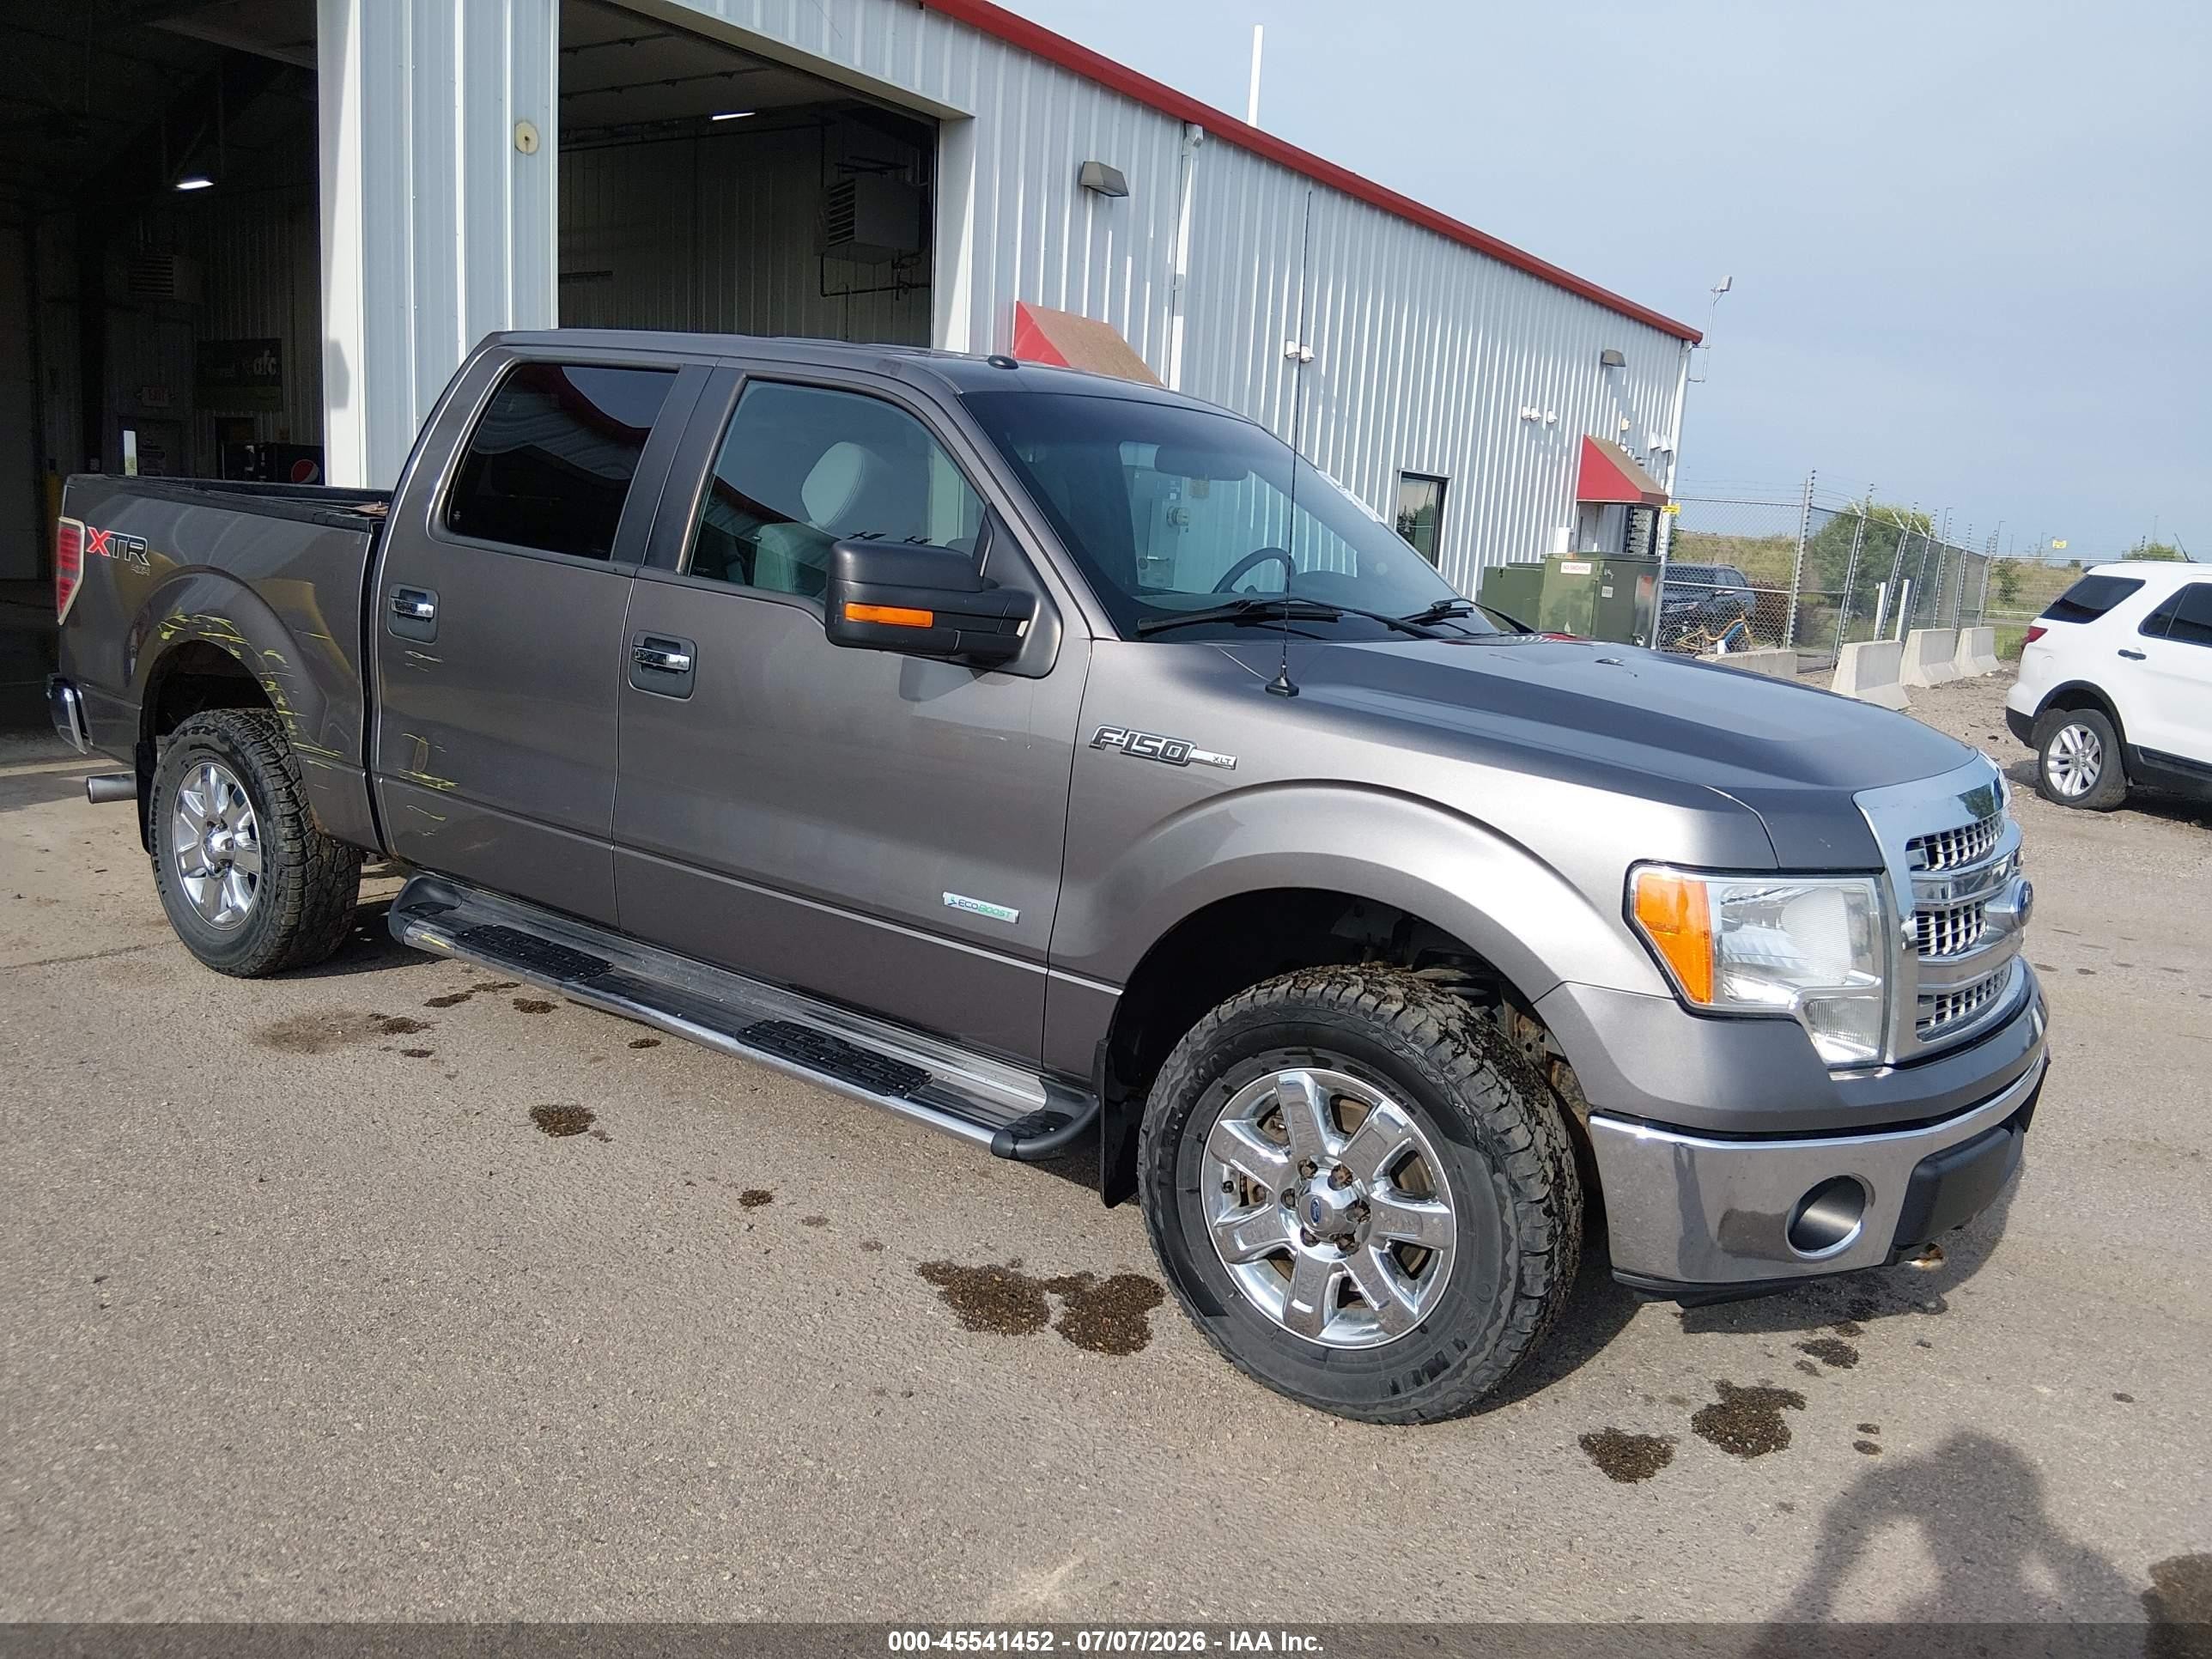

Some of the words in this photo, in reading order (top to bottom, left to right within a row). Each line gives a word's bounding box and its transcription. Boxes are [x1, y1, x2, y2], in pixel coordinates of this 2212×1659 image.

[86, 526, 151, 567] XTR
[1089, 725, 1198, 767] F-150
[1212, 756, 1231, 765] XLT
